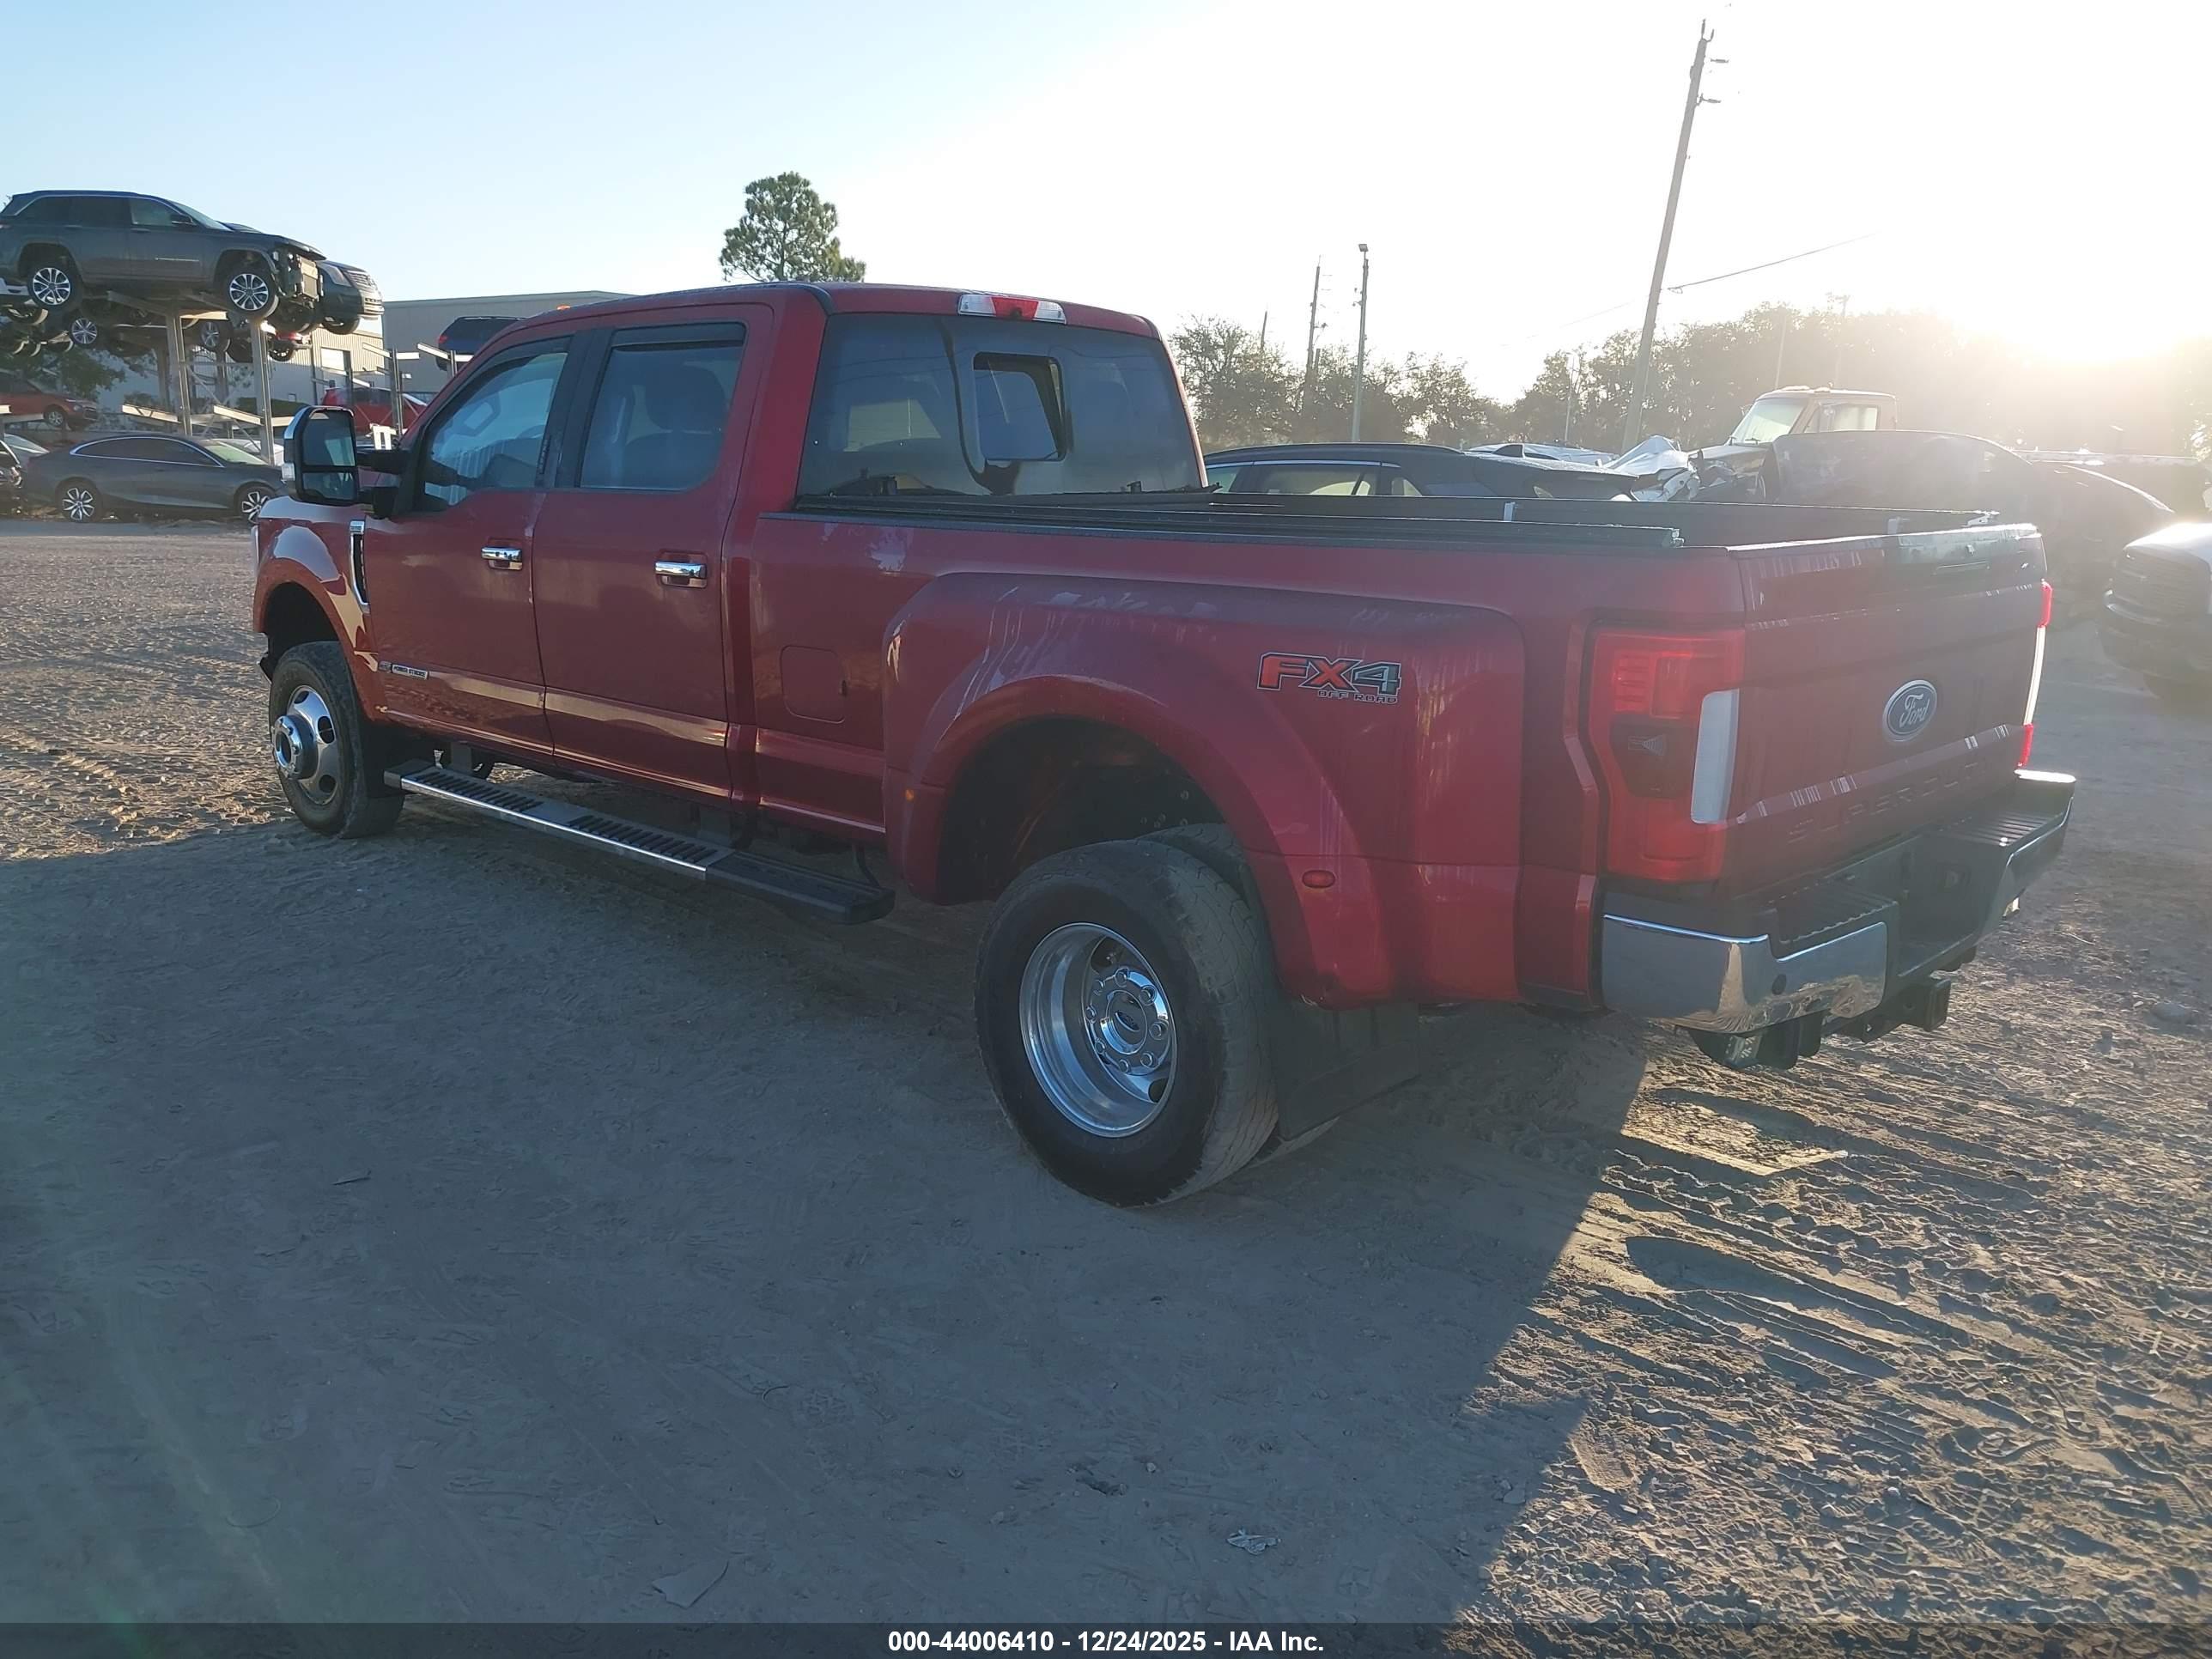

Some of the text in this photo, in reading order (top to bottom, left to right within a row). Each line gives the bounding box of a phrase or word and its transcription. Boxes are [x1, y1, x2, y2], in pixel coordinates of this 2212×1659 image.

[1257, 652, 1401, 696] FX4
[1318, 690, 1398, 704] OFF ROAD
[1899, 693, 1930, 728] Ford
